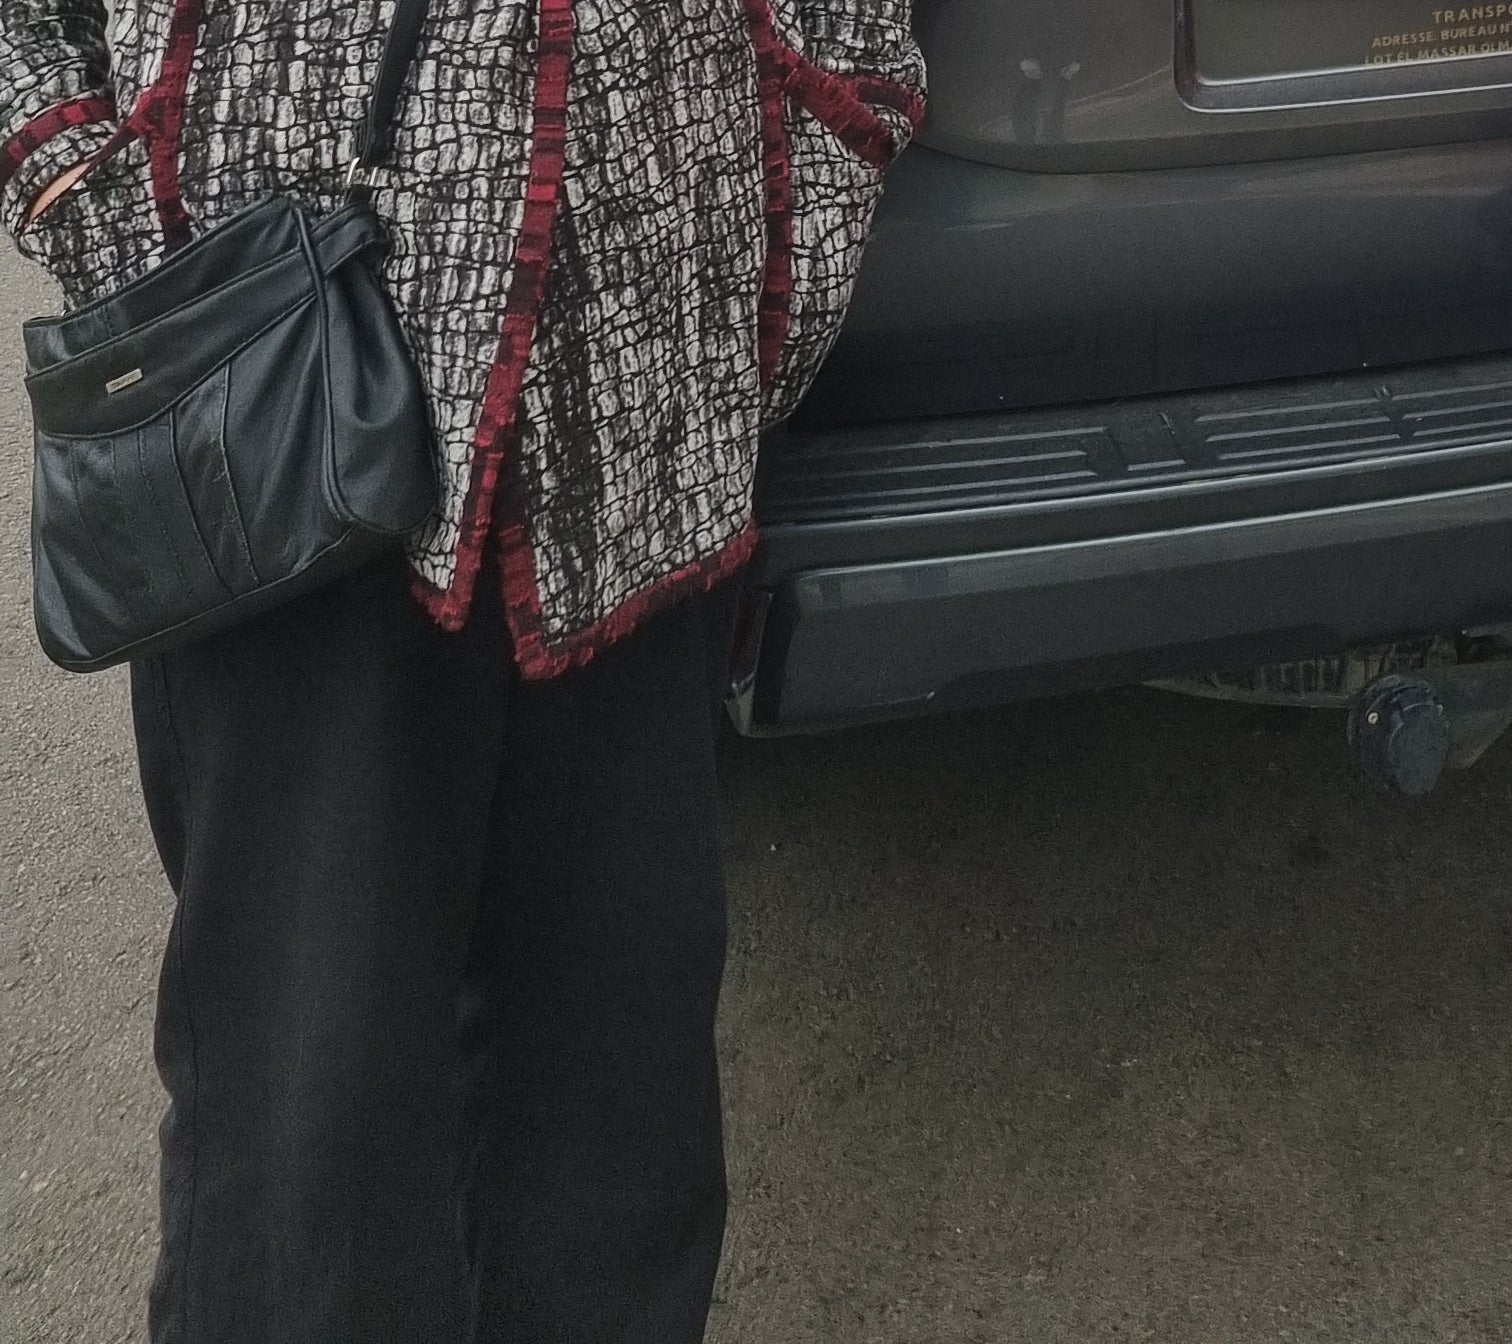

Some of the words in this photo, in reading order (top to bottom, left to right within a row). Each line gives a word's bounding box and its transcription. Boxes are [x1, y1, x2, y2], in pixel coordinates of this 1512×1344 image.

[1371, 30, 1435, 49] ADRESSE
[1440, 24, 1498, 42] BUREAU
[1417, 43, 1477, 61] MASSAR
